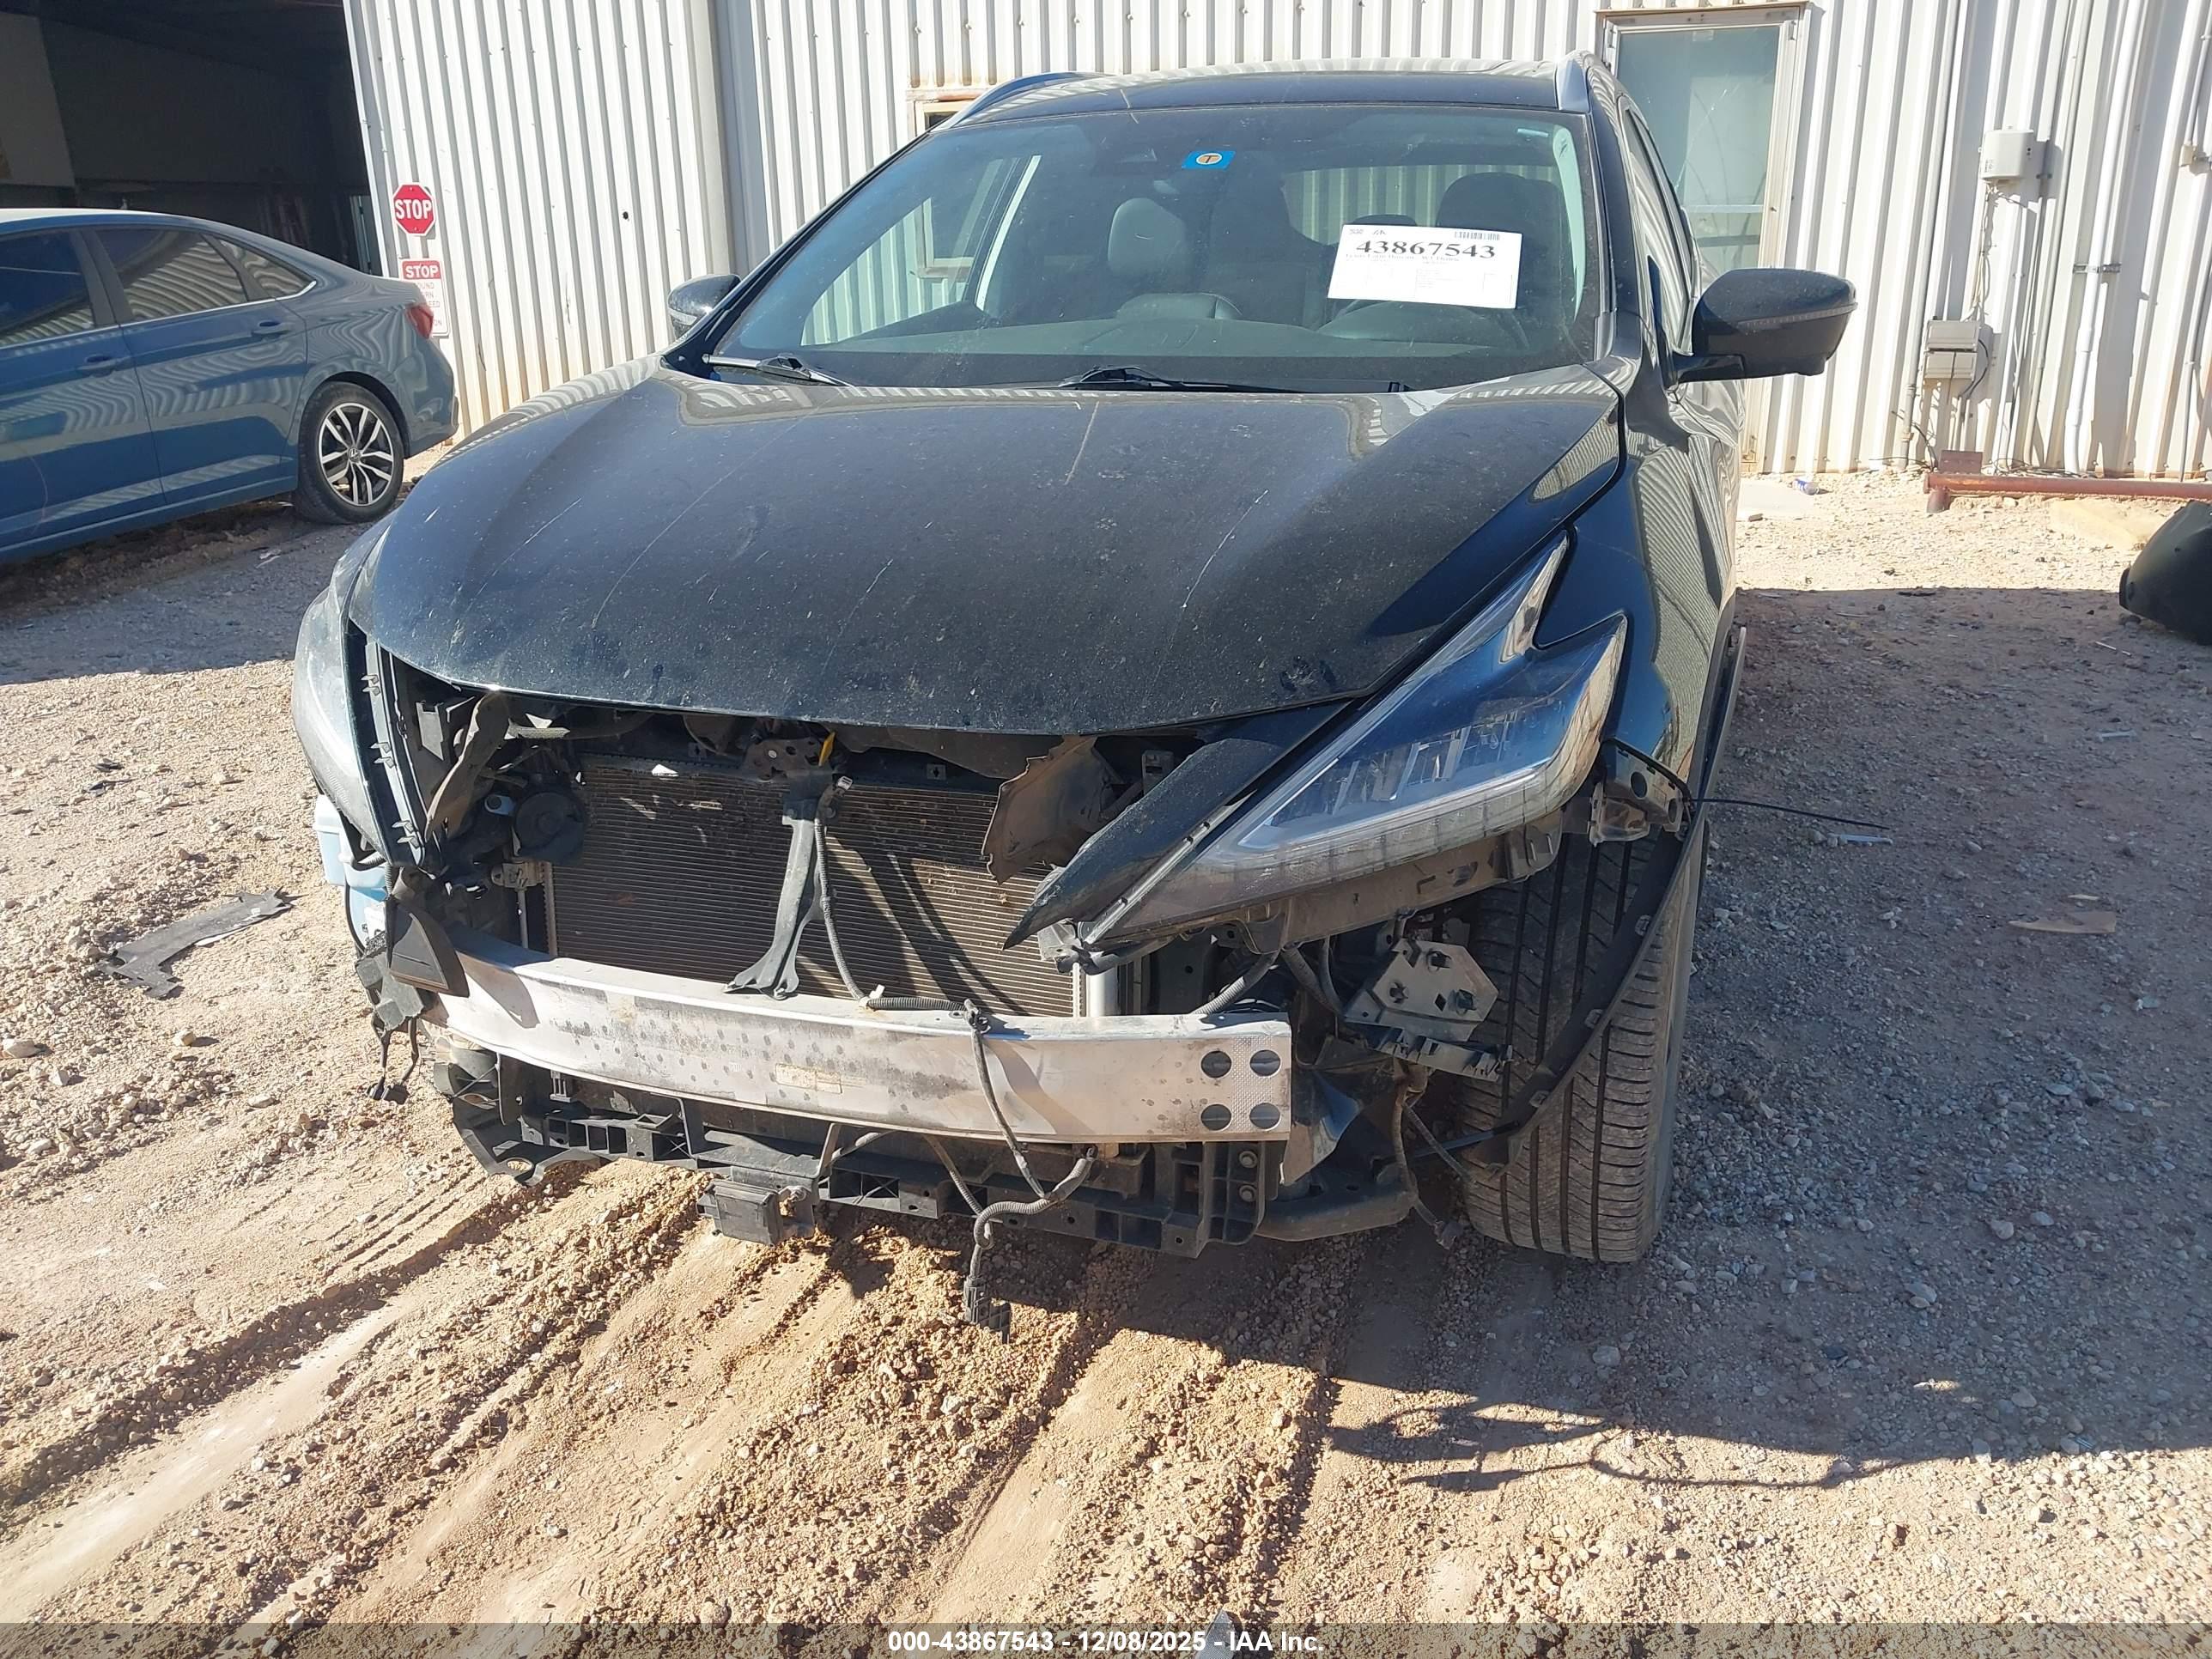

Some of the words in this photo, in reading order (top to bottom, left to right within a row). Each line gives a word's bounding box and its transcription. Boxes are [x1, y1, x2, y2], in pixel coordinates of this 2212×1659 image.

[394, 198, 433, 221] STOP
[1355, 240, 1496, 259] 43867543
[404, 264, 440, 279] STOP
